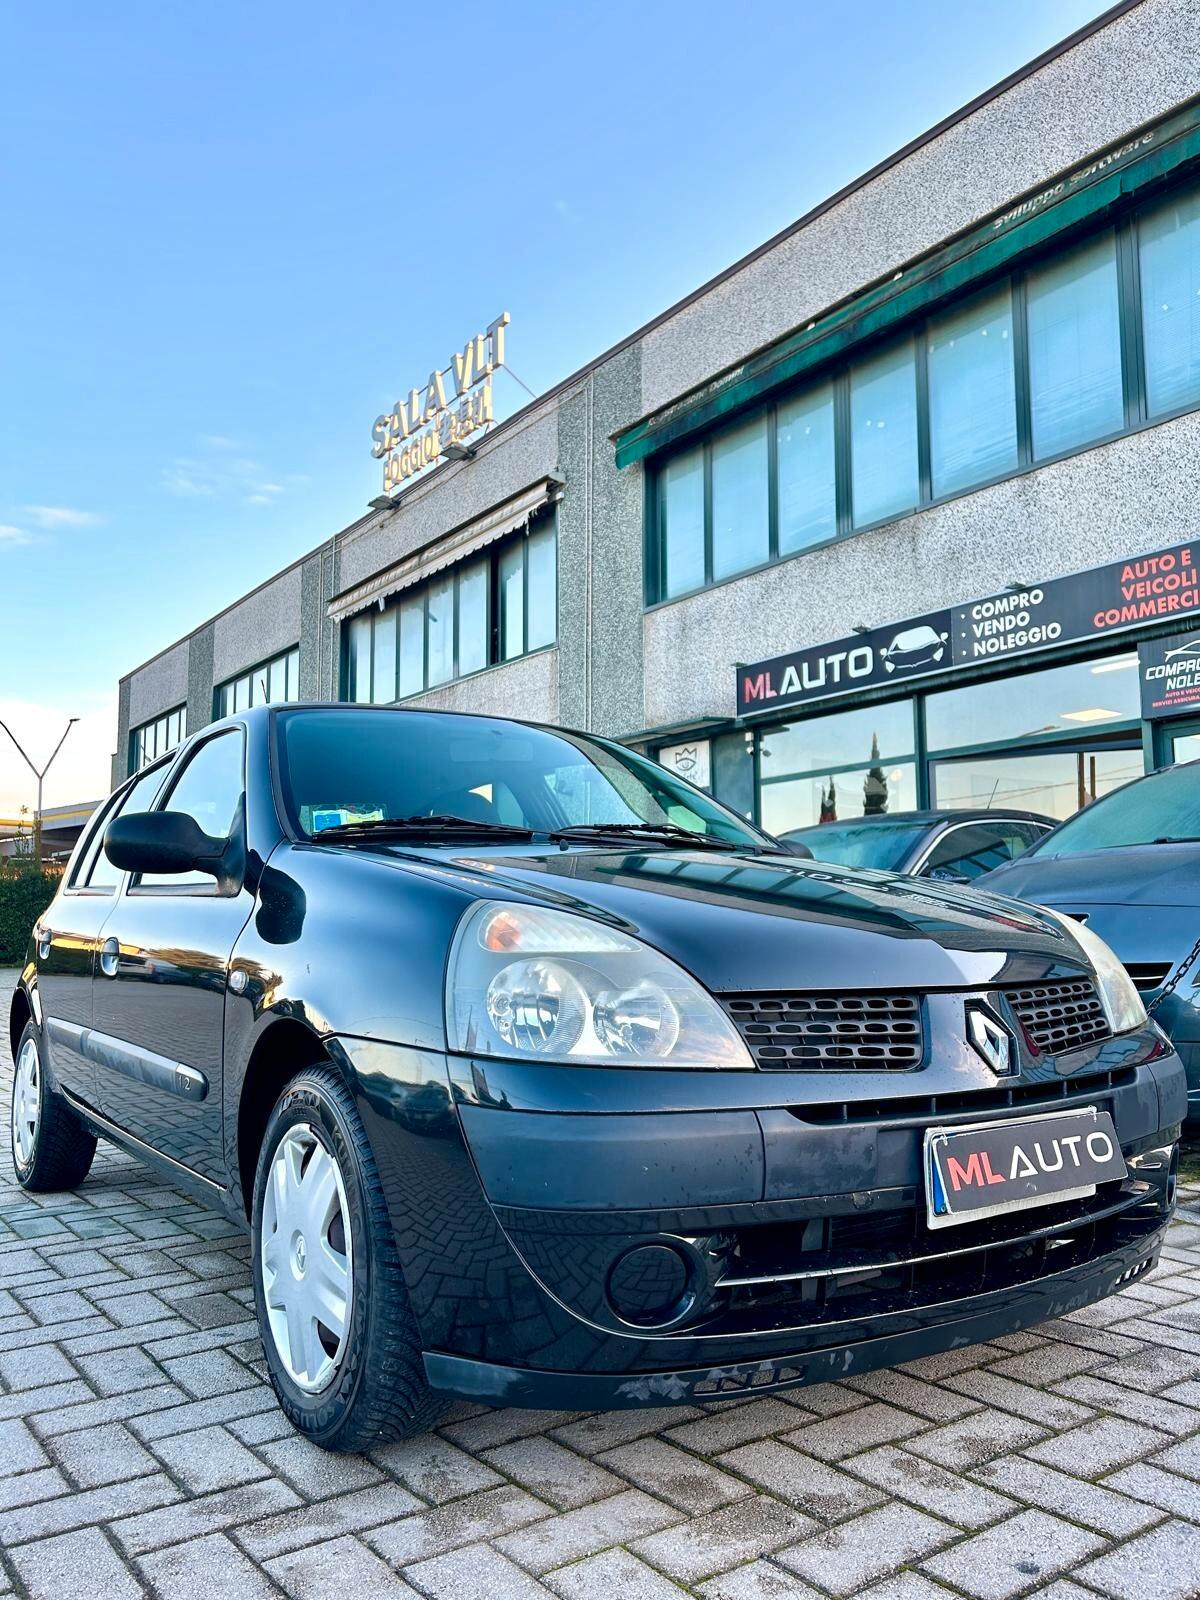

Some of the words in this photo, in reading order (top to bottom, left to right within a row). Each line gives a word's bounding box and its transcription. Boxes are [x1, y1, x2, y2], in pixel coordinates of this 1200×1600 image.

[371, 369, 448, 459] SALA
[450, 312, 511, 397] VLT
[1120, 553, 1176, 583] AUTO
[1181, 549, 1192, 567] E
[1121, 568, 1197, 601] VEICOLI
[972, 589, 1044, 620] COMPRO
[1093, 588, 1200, 628] COMMERCI
[972, 611, 1030, 638] VENDO
[973, 622, 1062, 657] NOLEGGIO
